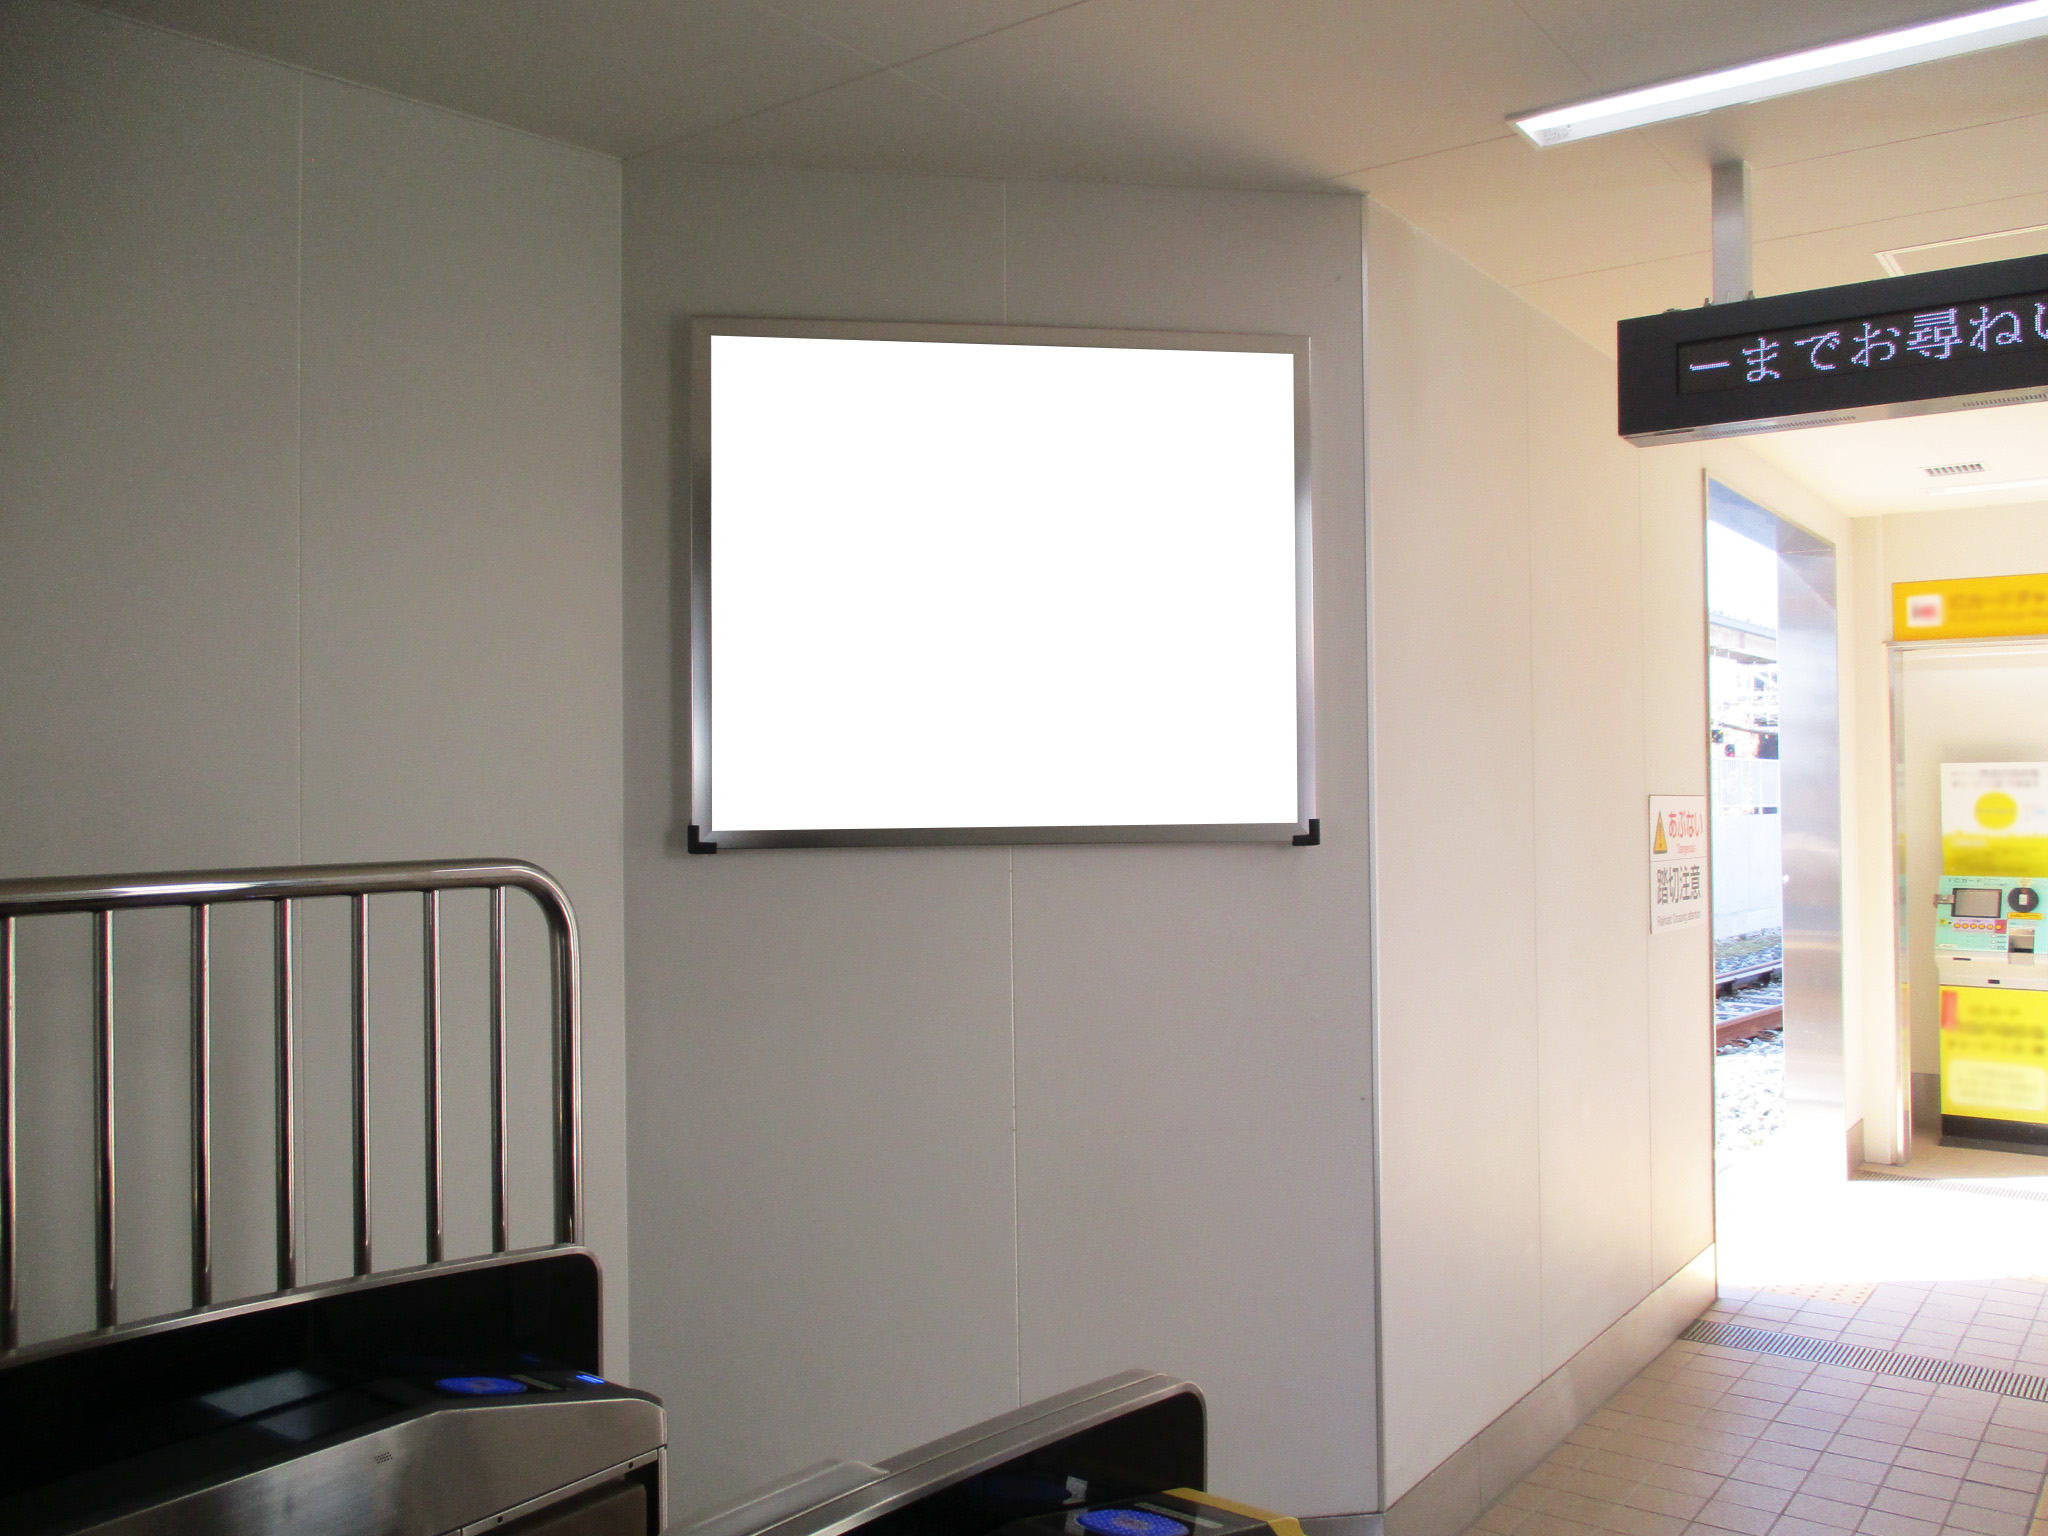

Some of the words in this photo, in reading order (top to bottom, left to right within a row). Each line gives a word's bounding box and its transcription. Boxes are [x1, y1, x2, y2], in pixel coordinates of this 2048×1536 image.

[1668, 811, 1703, 838] あぶない
[1657, 865, 1701, 905] 踏切注意
